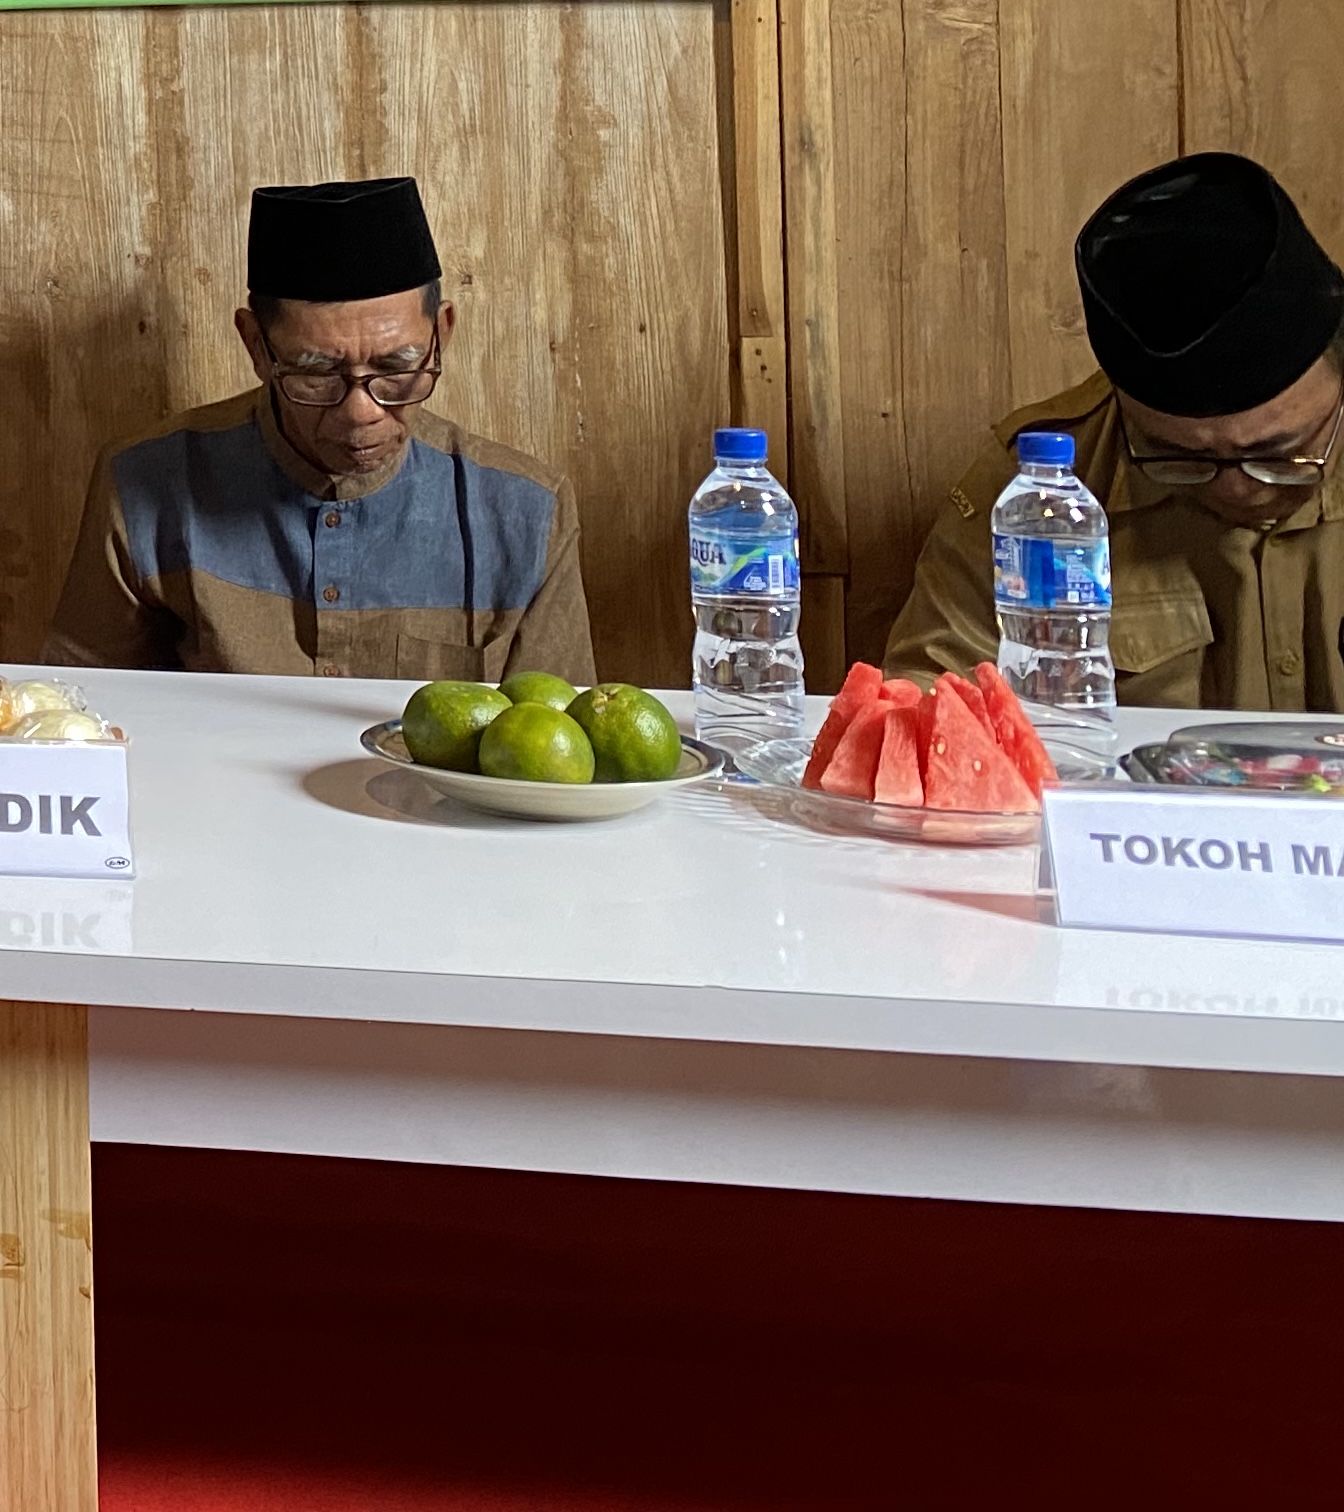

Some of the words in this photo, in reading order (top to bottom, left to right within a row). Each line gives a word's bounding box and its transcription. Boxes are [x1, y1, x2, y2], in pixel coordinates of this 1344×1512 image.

[692, 538, 728, 567] QUA
[1089, 832, 1274, 874] TOKOH
[1291, 843, 1344, 878] M
